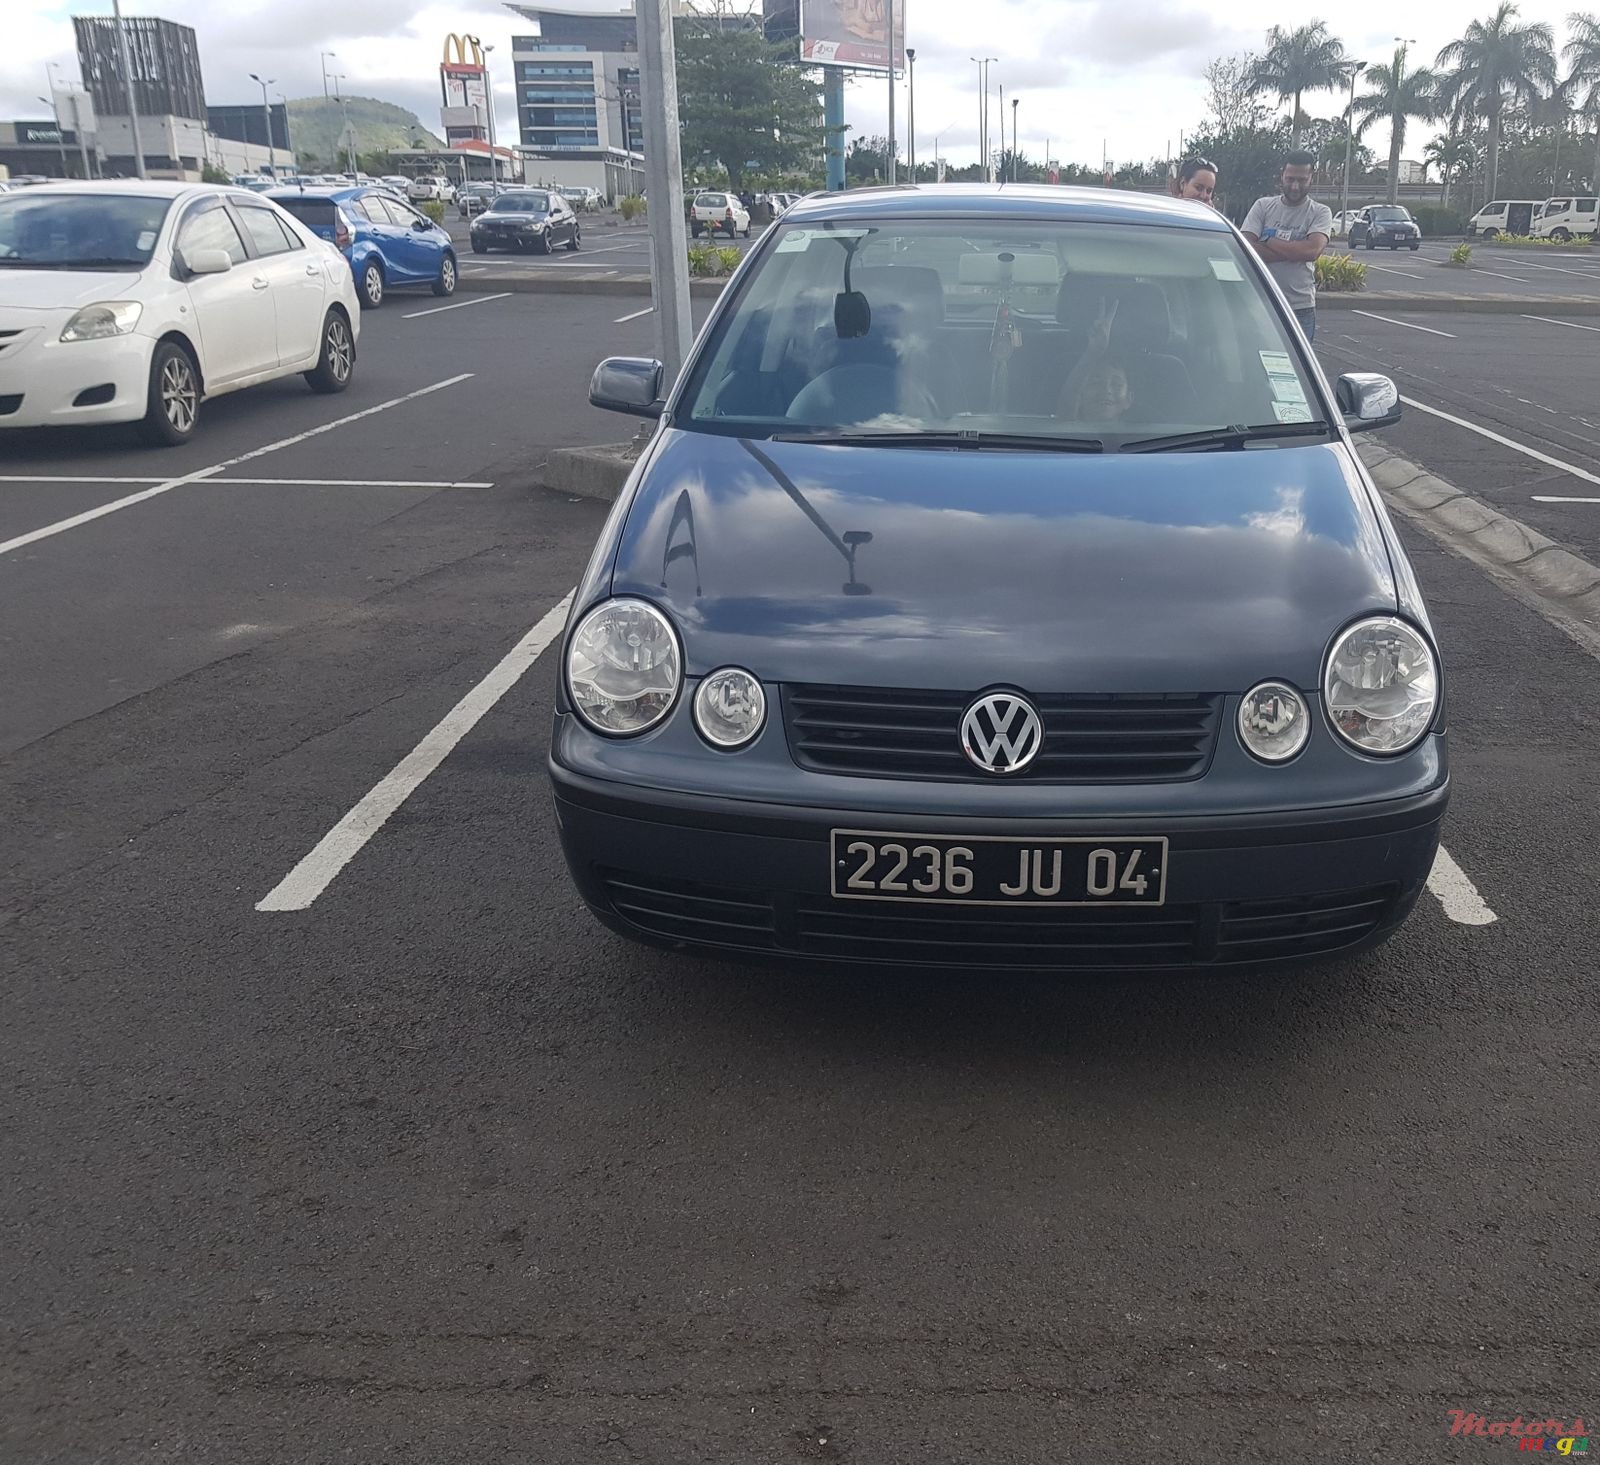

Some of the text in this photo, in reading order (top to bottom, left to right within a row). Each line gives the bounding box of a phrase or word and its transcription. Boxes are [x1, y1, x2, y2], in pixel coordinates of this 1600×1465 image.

[962, 694, 1041, 773] VW
[847, 841, 1148, 896] 2236 JU 04
